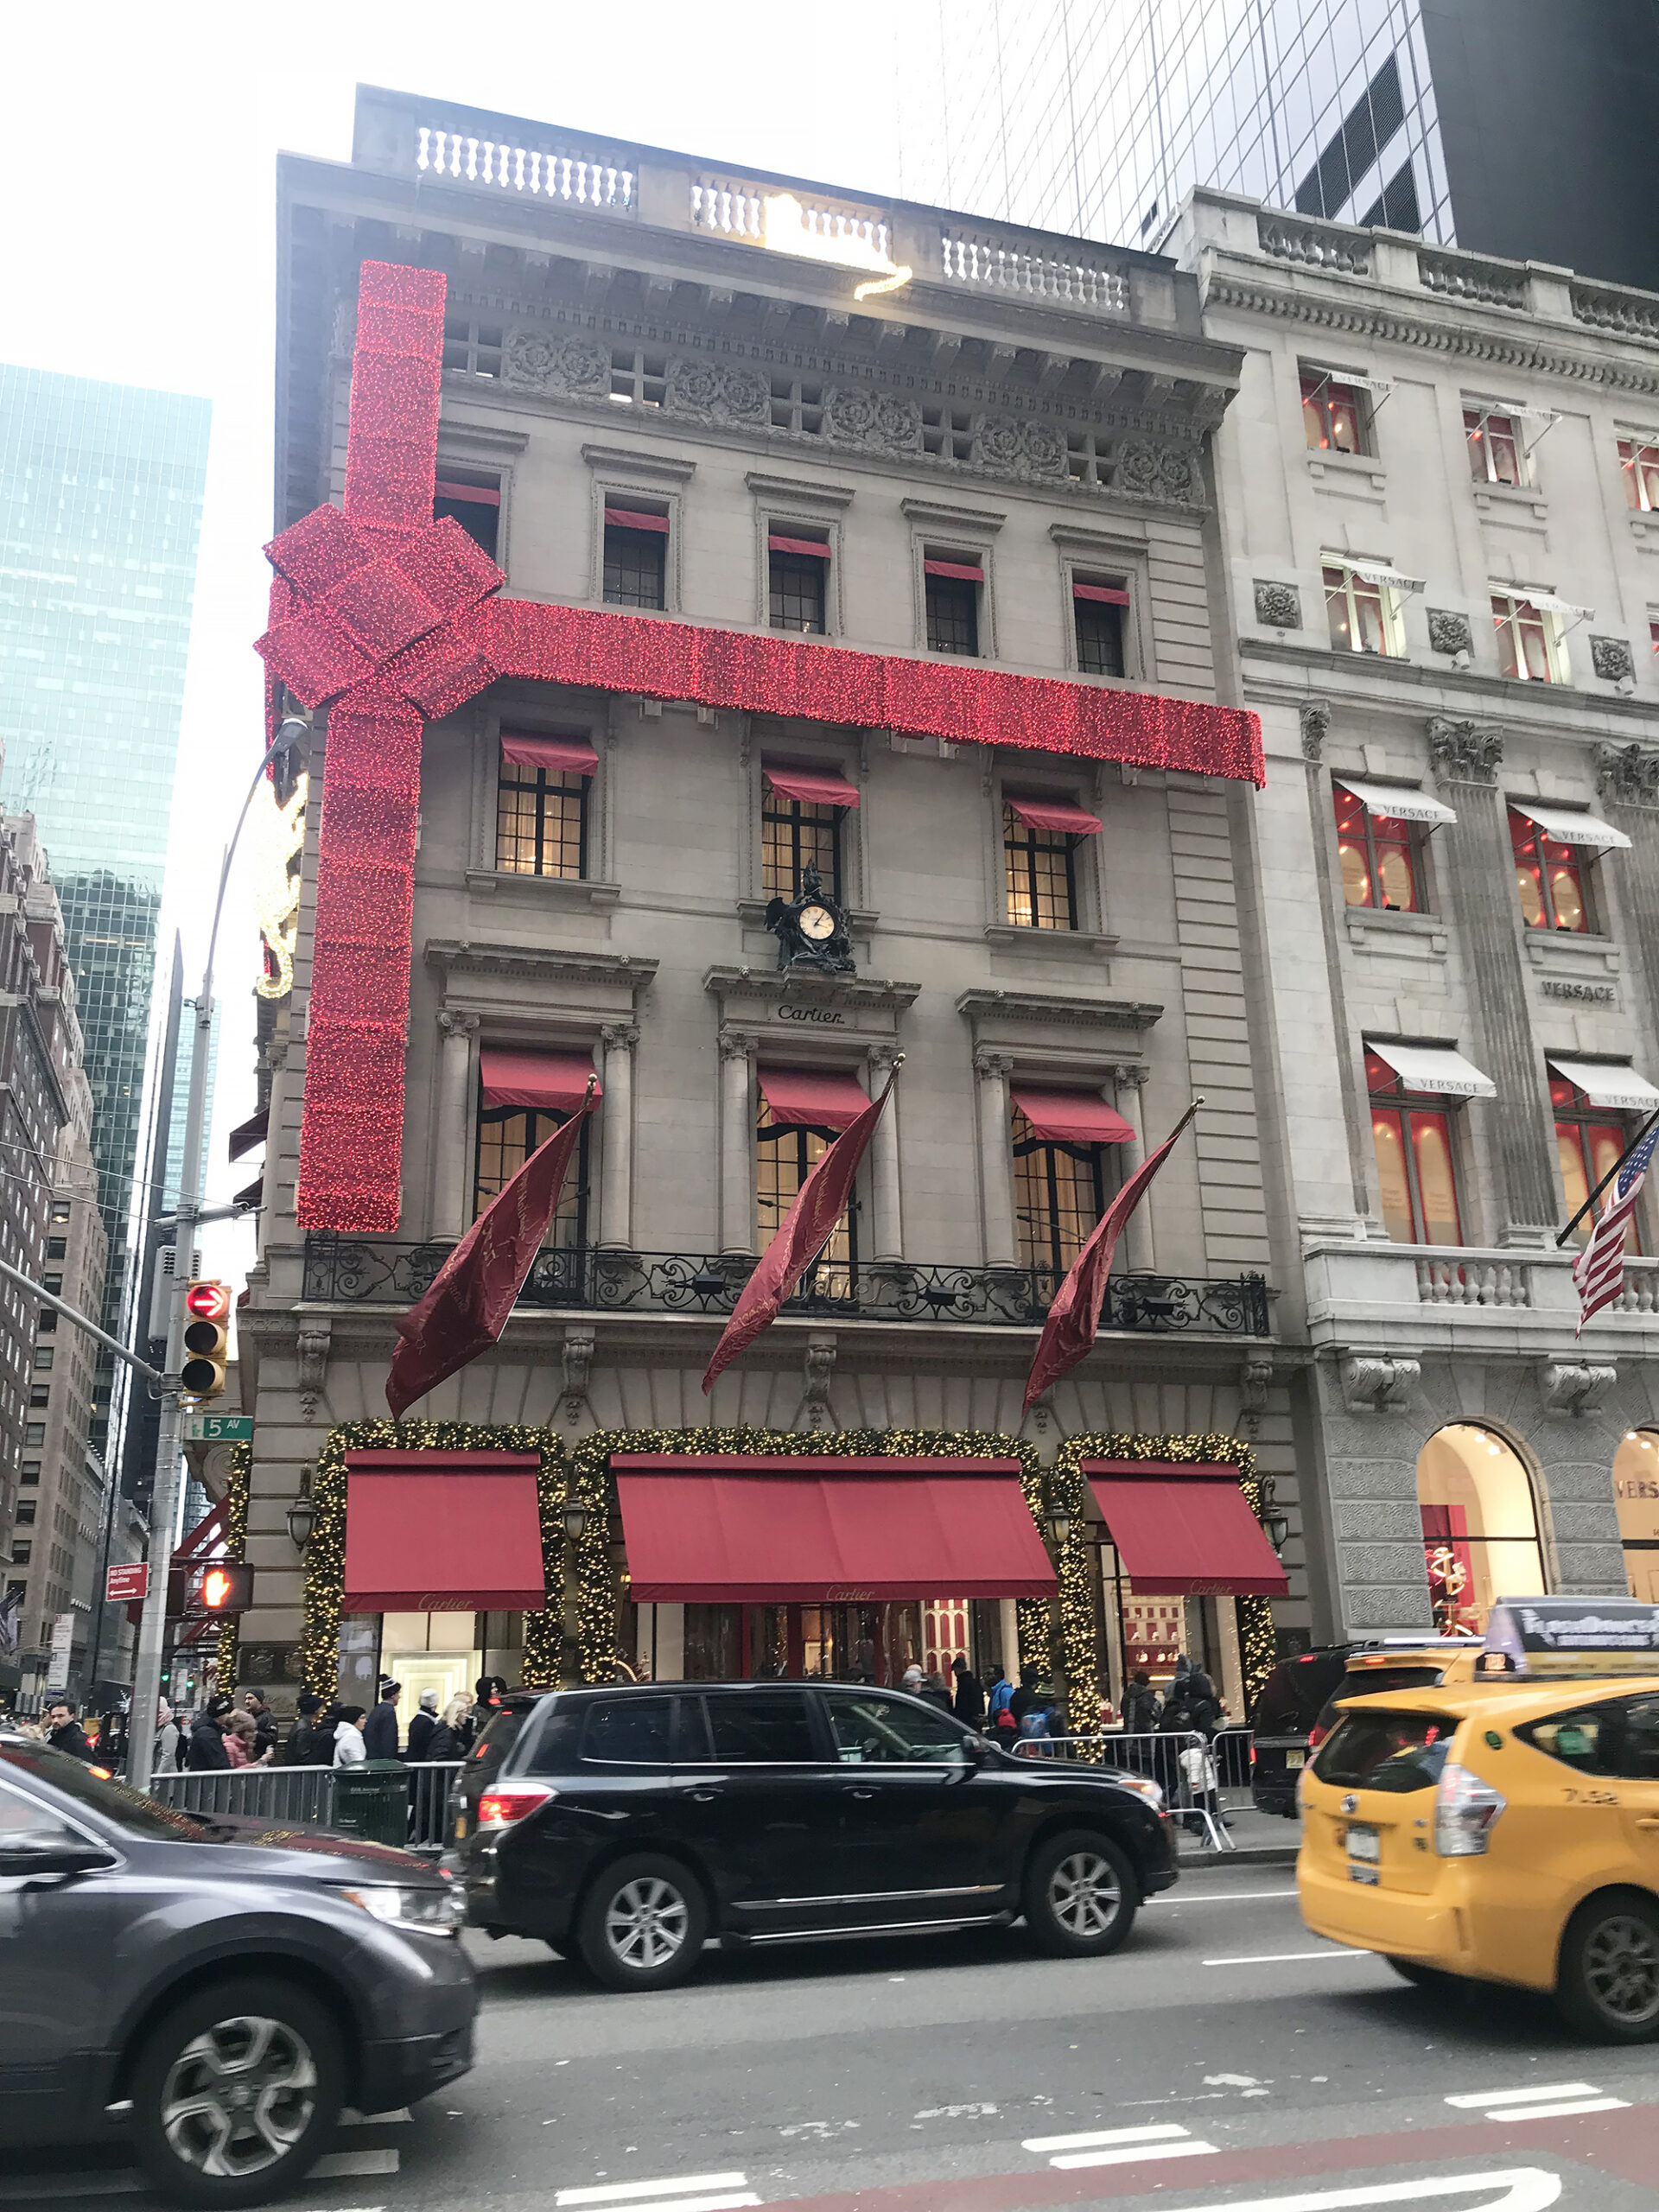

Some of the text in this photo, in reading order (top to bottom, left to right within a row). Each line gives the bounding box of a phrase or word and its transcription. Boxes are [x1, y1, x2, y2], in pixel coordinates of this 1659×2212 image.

[1364, 573, 1418, 589] VERSACE
[1382, 804, 1440, 820] VERSACE
[1561, 830, 1615, 844] VERSACE
[1541, 980, 1617, 1002] VERSACE
[778, 1004, 845, 1025] Cartier
[1420, 1077, 1480, 1094] VERSACE
[208, 1419, 240, 1437] 5 AV
[826, 1583, 876, 1601] Cartier
[1191, 1578, 1234, 1595] Cartier
[418, 1592, 474, 1611] Cartier
